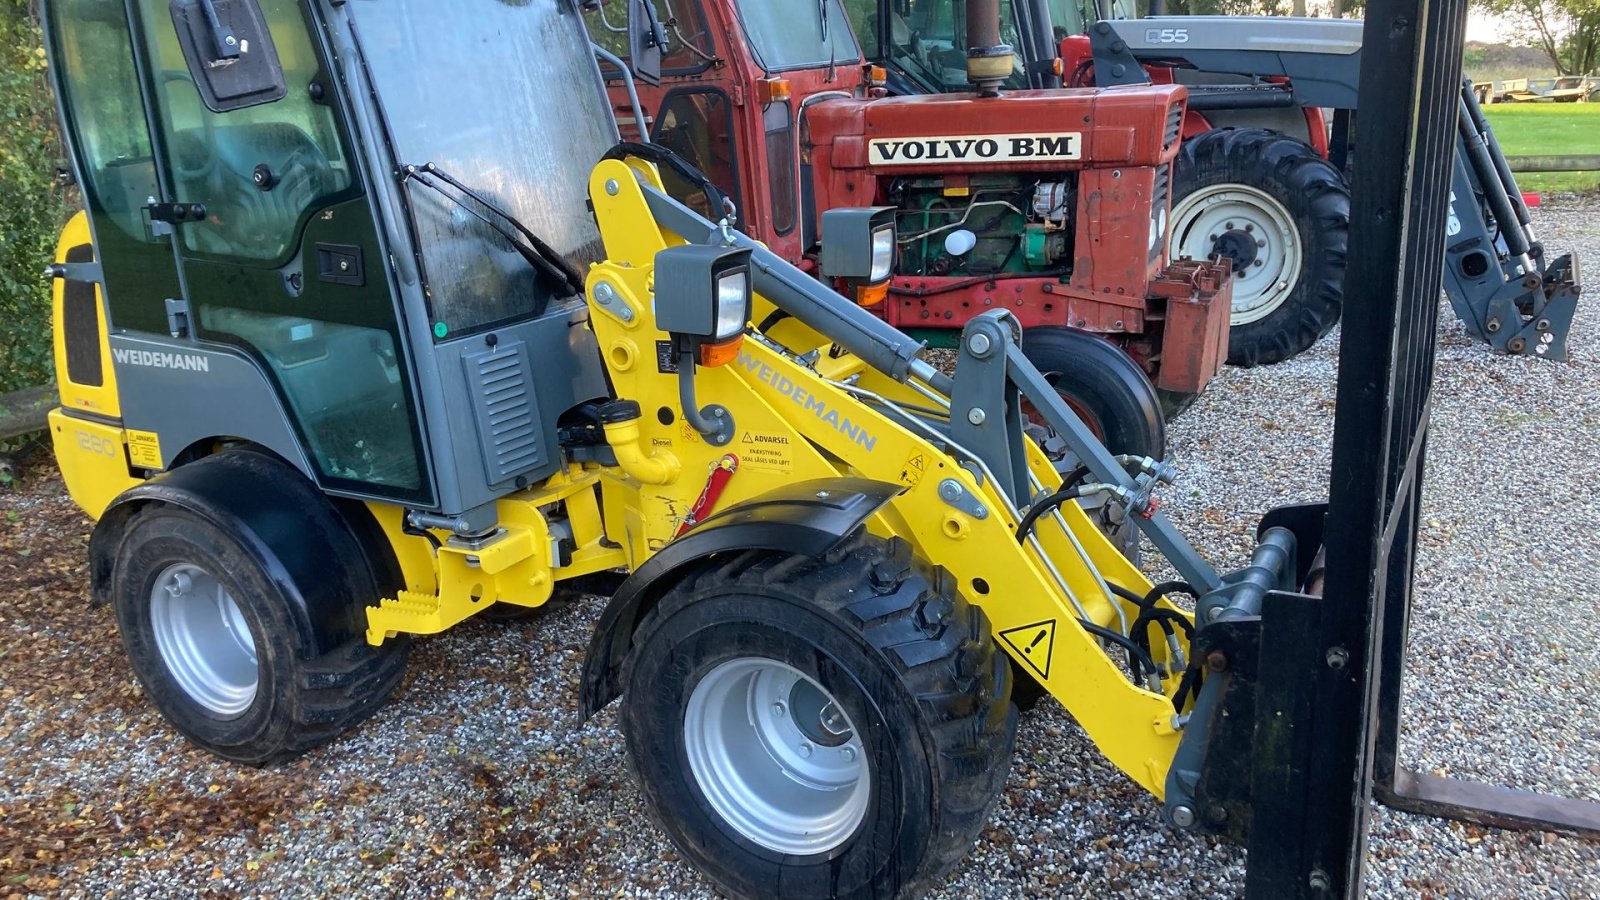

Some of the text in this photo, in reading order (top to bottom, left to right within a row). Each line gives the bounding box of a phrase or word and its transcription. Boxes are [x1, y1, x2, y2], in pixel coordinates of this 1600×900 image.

[1145, 28, 1189, 44] Q55
[873, 136, 1073, 160] VOLVO BM
[112, 348, 208, 372] WEIDEMANN
[736, 350, 878, 452] WEIDEMANN
[75, 430, 116, 458] 1280
[652, 438, 672, 446] Diesel
[754, 435, 788, 444] ADVARSEL
